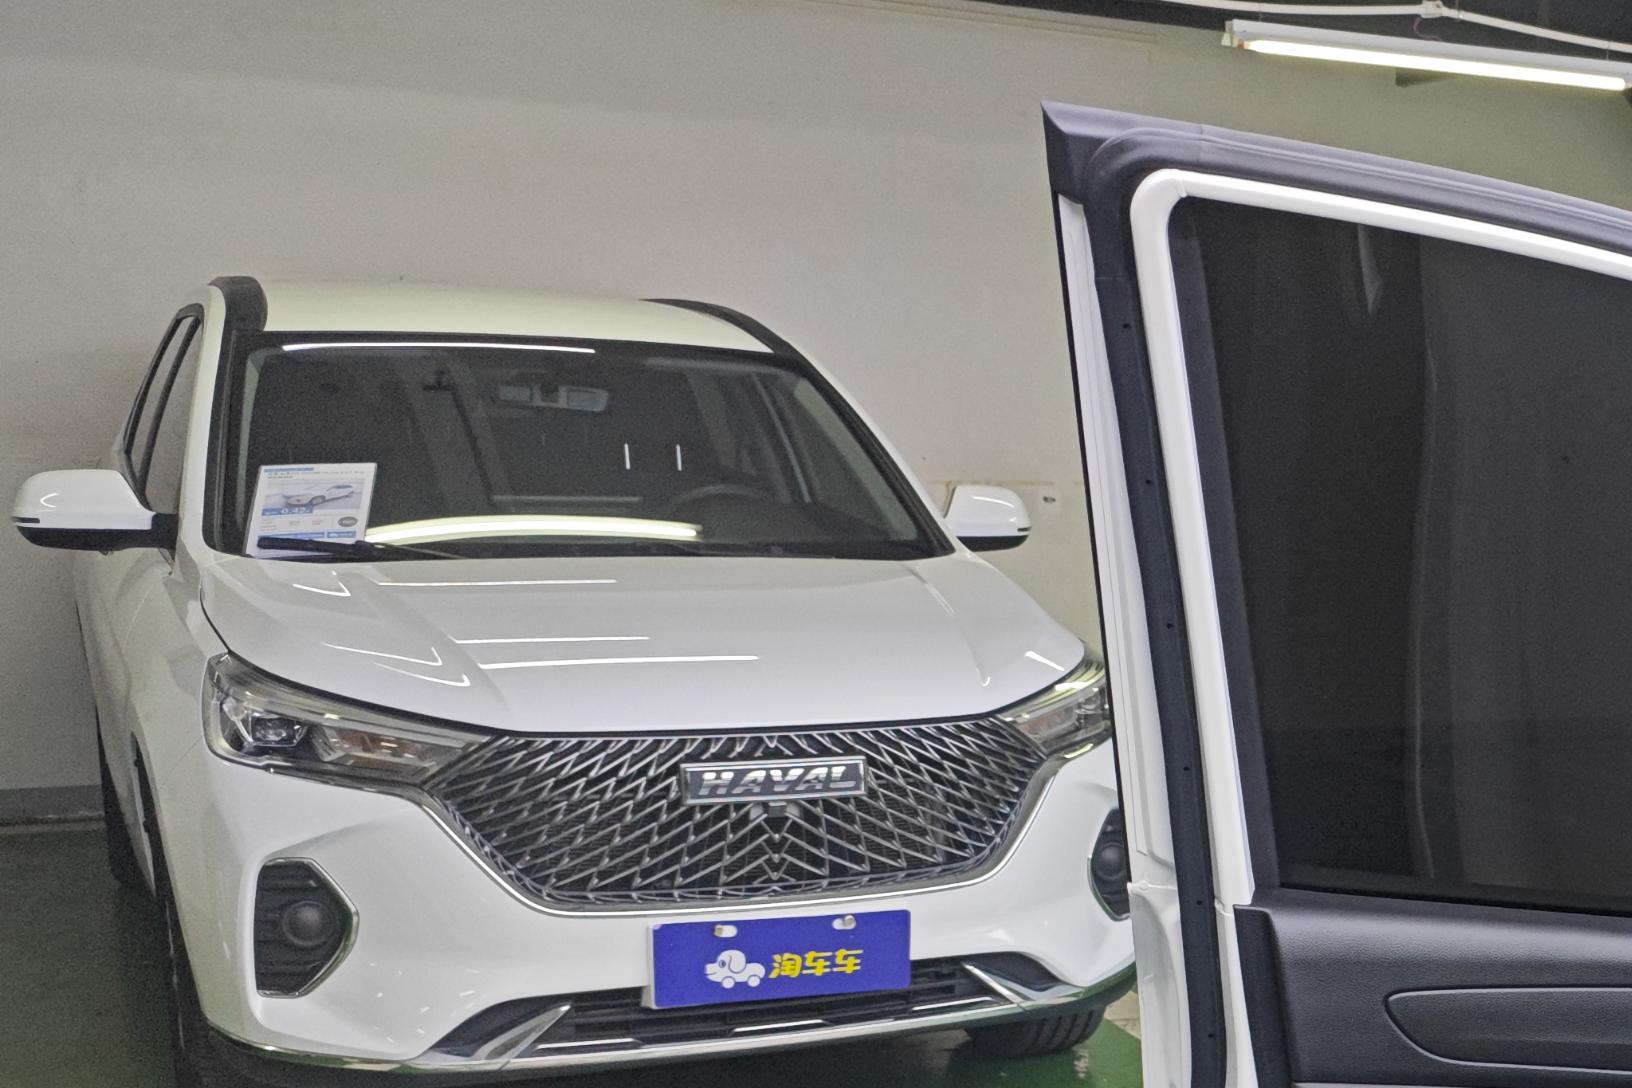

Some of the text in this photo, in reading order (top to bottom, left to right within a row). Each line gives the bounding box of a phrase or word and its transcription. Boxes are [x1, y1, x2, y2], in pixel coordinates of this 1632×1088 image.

[699, 765, 856, 796] HAVAL
[768, 948, 864, 979] 淘车车
